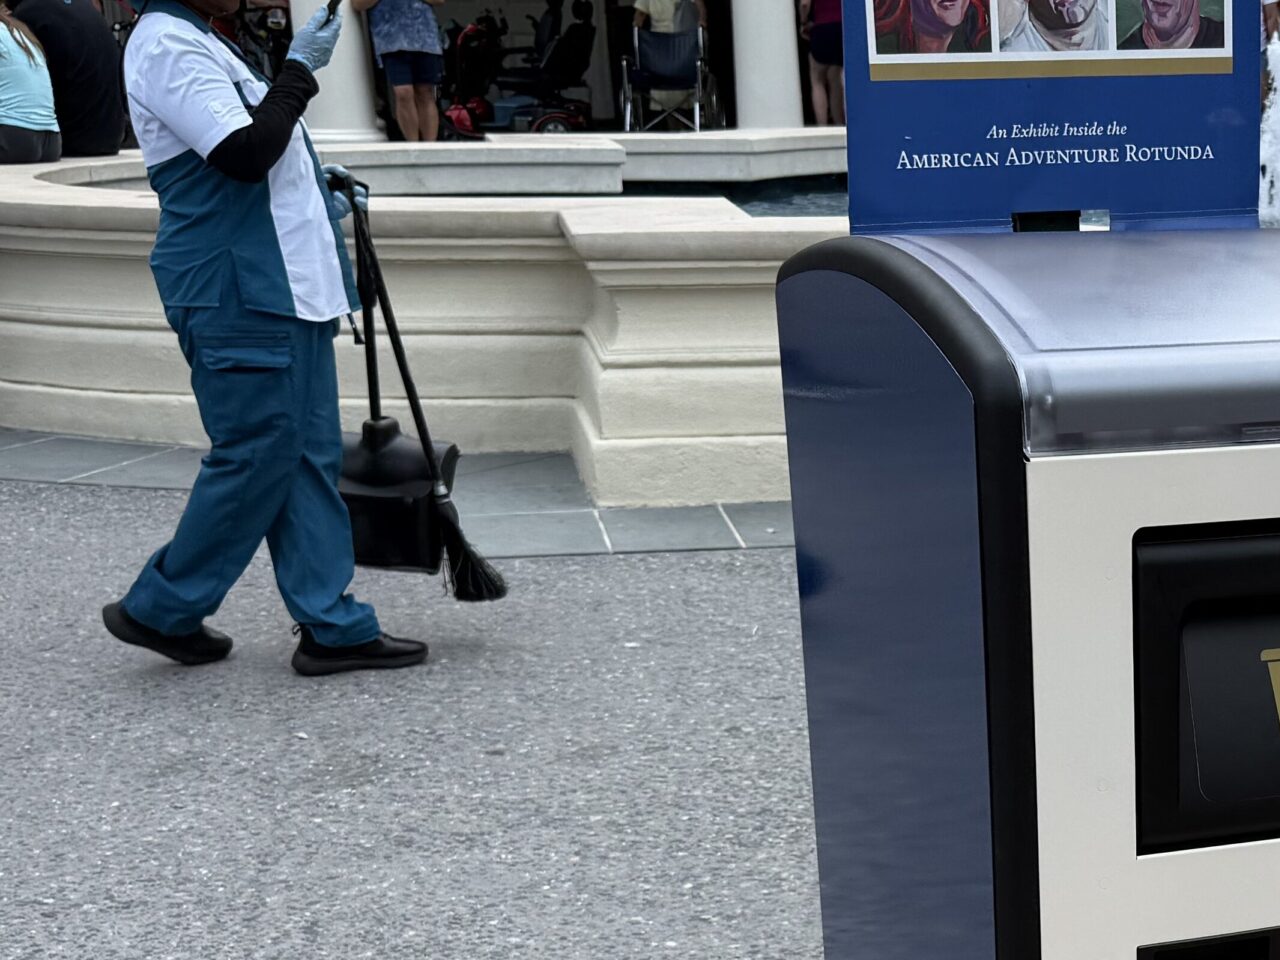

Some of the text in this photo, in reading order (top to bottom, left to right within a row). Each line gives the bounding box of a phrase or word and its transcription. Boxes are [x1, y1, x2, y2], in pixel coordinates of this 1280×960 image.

[986, 121, 1127, 139] An Exhibit Inside the
[896, 143, 1215, 169] AMERICAN ADVENTURE ROTUNDA
